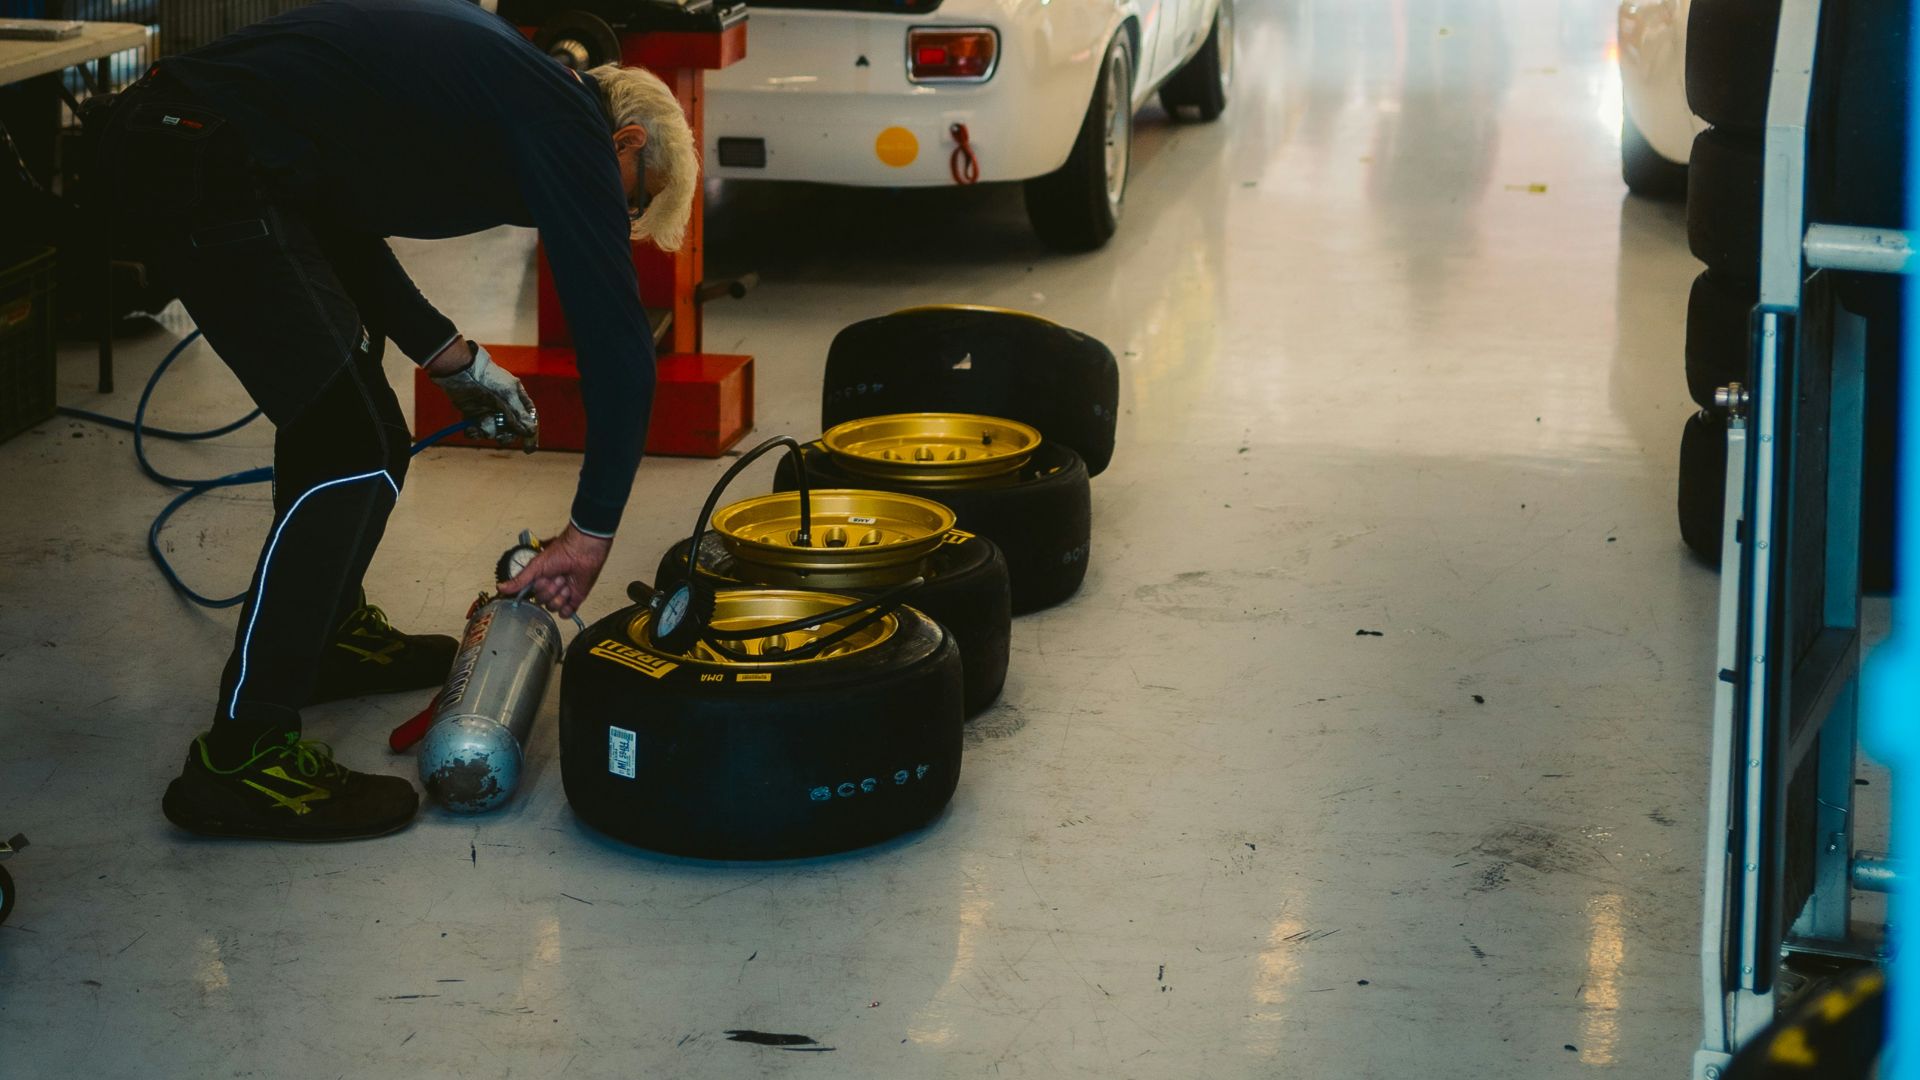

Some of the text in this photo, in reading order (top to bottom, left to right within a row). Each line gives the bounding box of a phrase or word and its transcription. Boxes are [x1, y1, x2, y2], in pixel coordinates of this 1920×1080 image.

[589, 639, 680, 679] PIRELLI
[700, 673, 724, 682] DMA
[893, 763, 930, 785] 46
